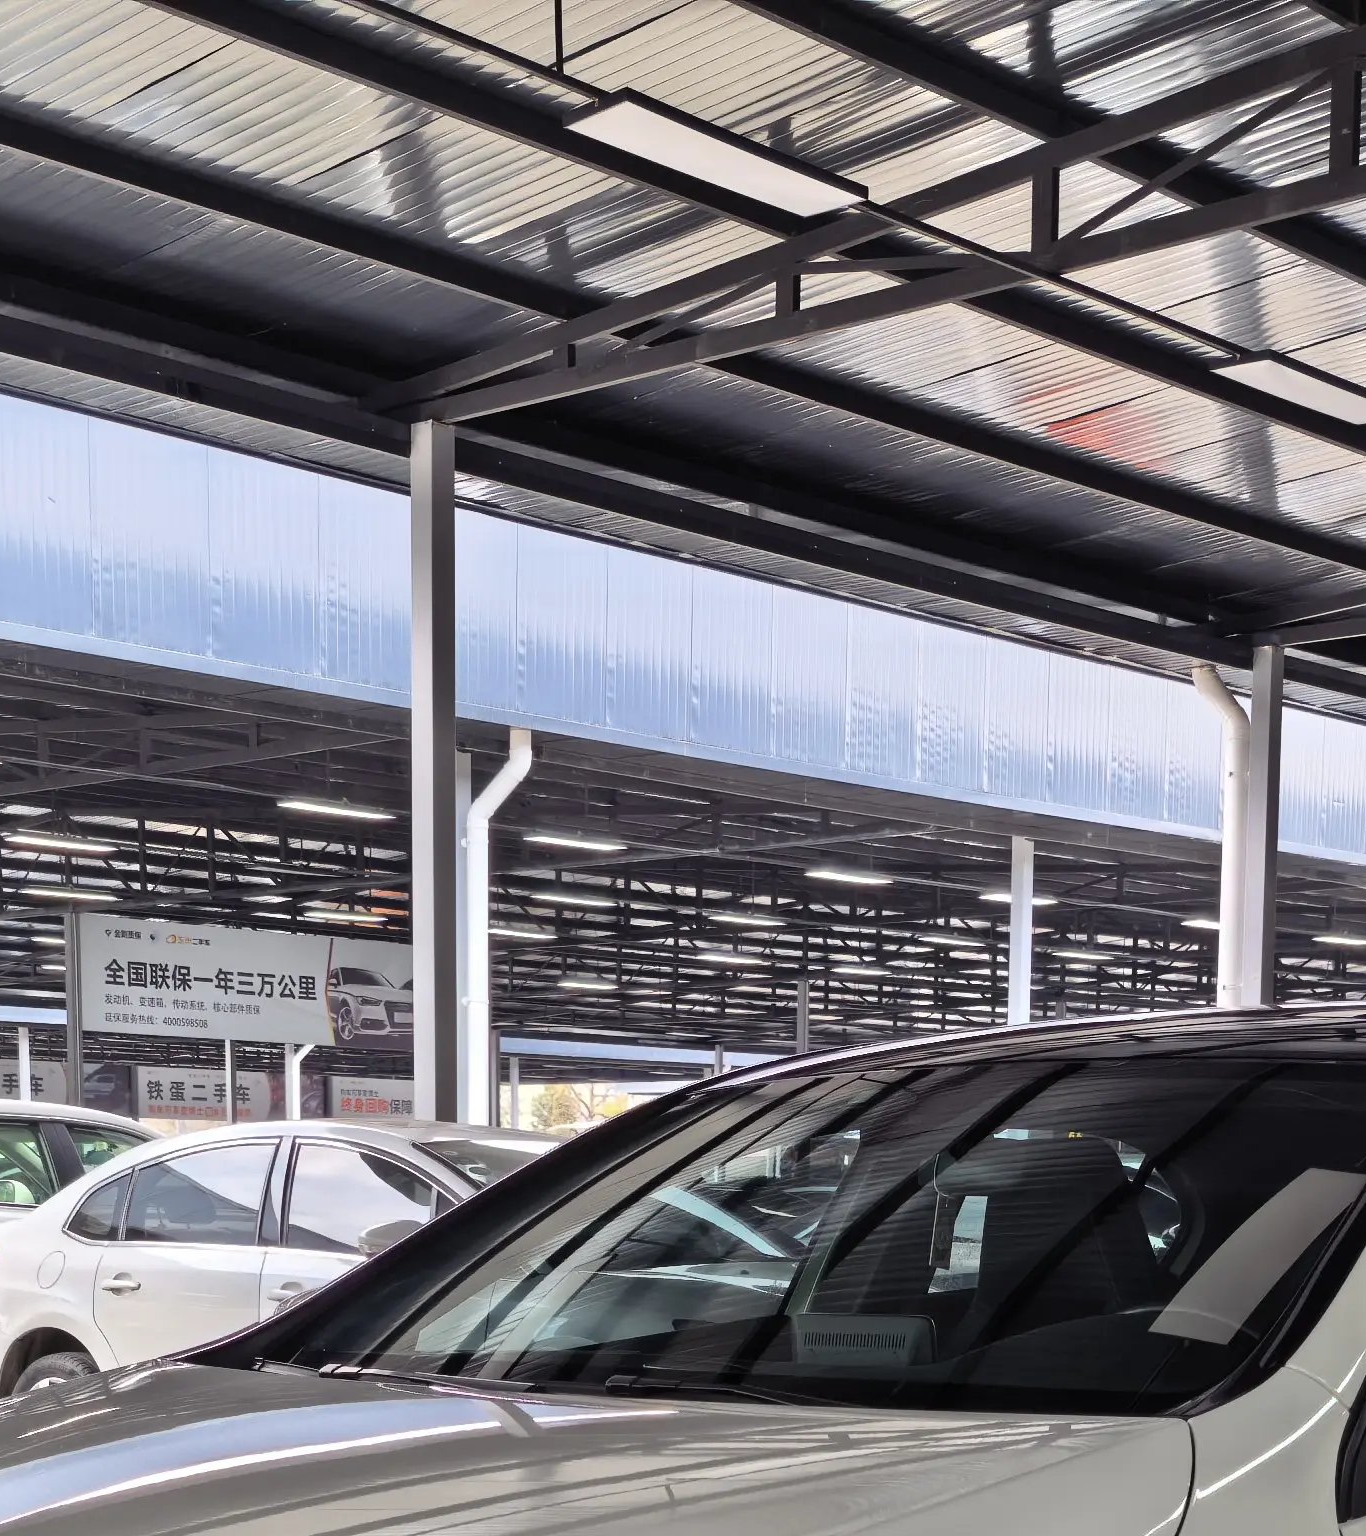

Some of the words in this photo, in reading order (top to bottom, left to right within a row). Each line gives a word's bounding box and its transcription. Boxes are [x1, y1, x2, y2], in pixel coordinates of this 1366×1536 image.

[104, 957, 317, 1000] 全国联保一年三万公里
[146, 1079, 251, 1104] 铁蛋二手车
